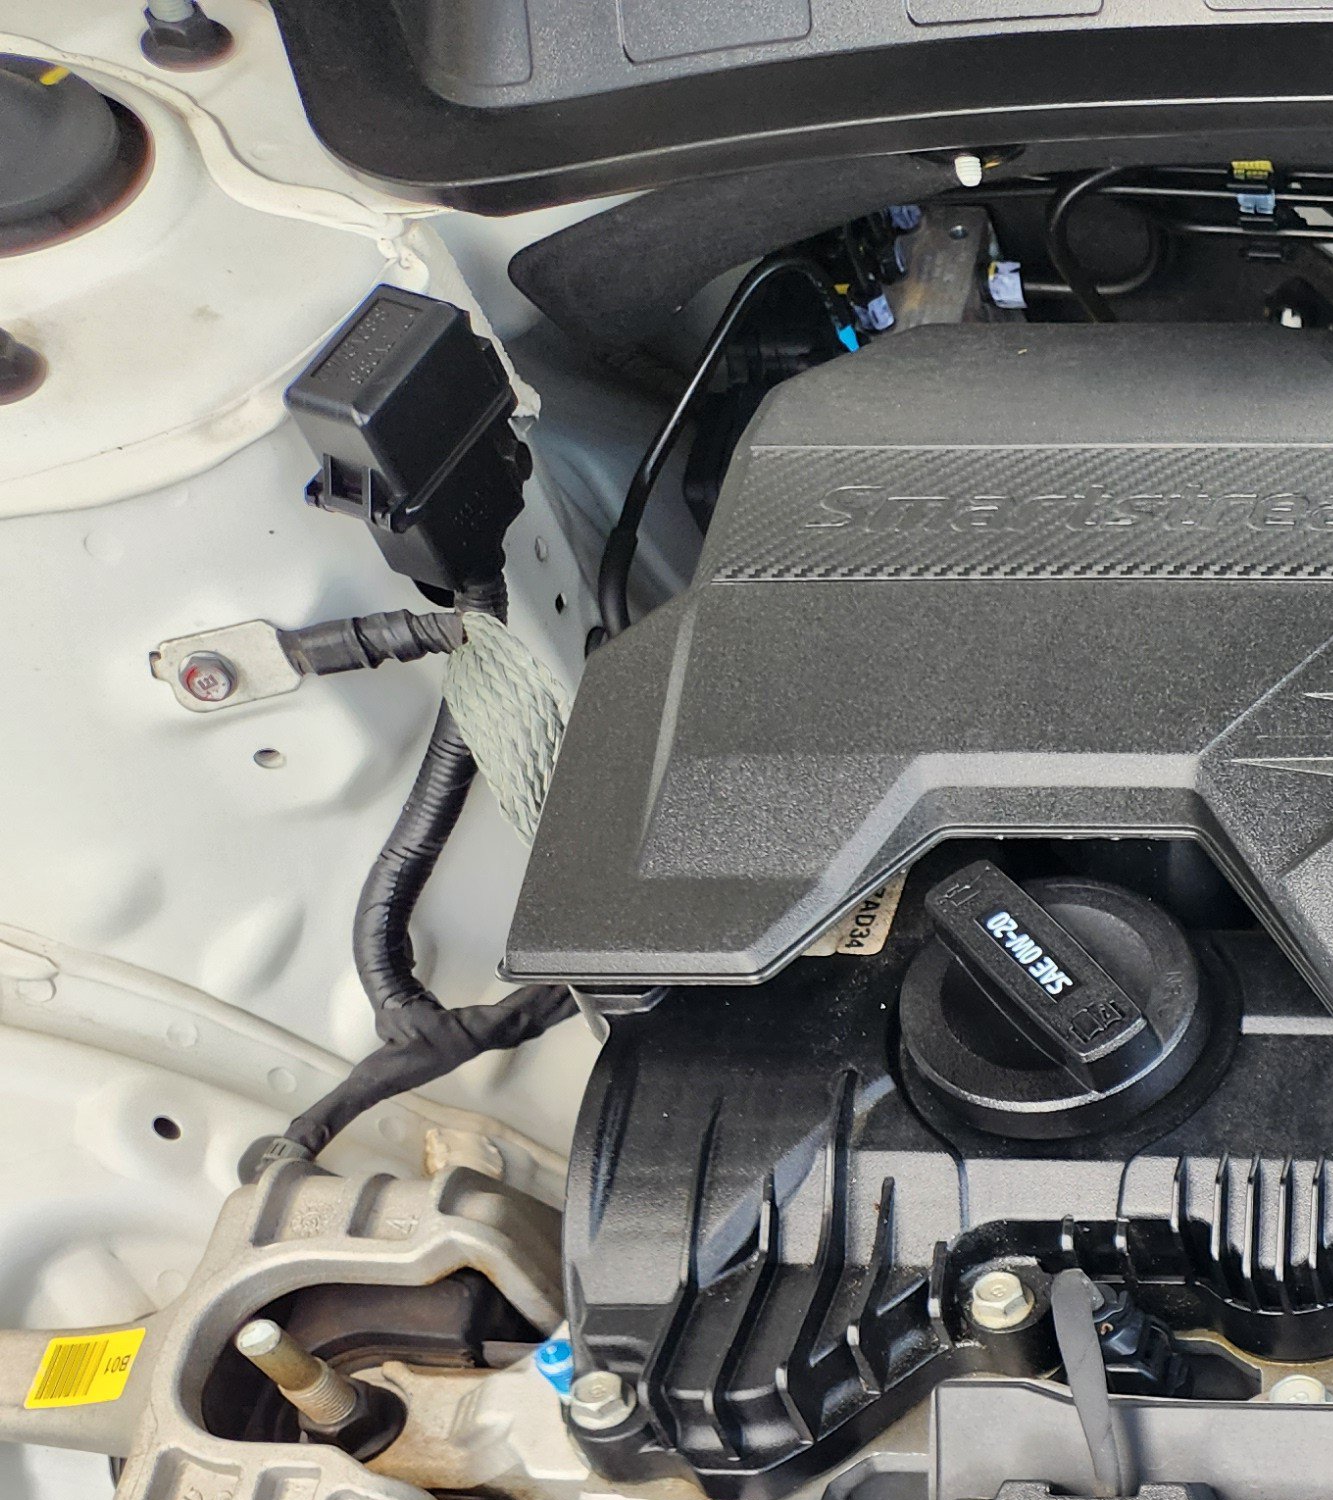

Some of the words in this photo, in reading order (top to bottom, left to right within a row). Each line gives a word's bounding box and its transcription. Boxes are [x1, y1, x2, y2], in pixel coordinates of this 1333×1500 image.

[986, 910, 1044, 966] 0W-20
[1028, 954, 1074, 996] SAE
[104, 1355, 131, 1374] B01
